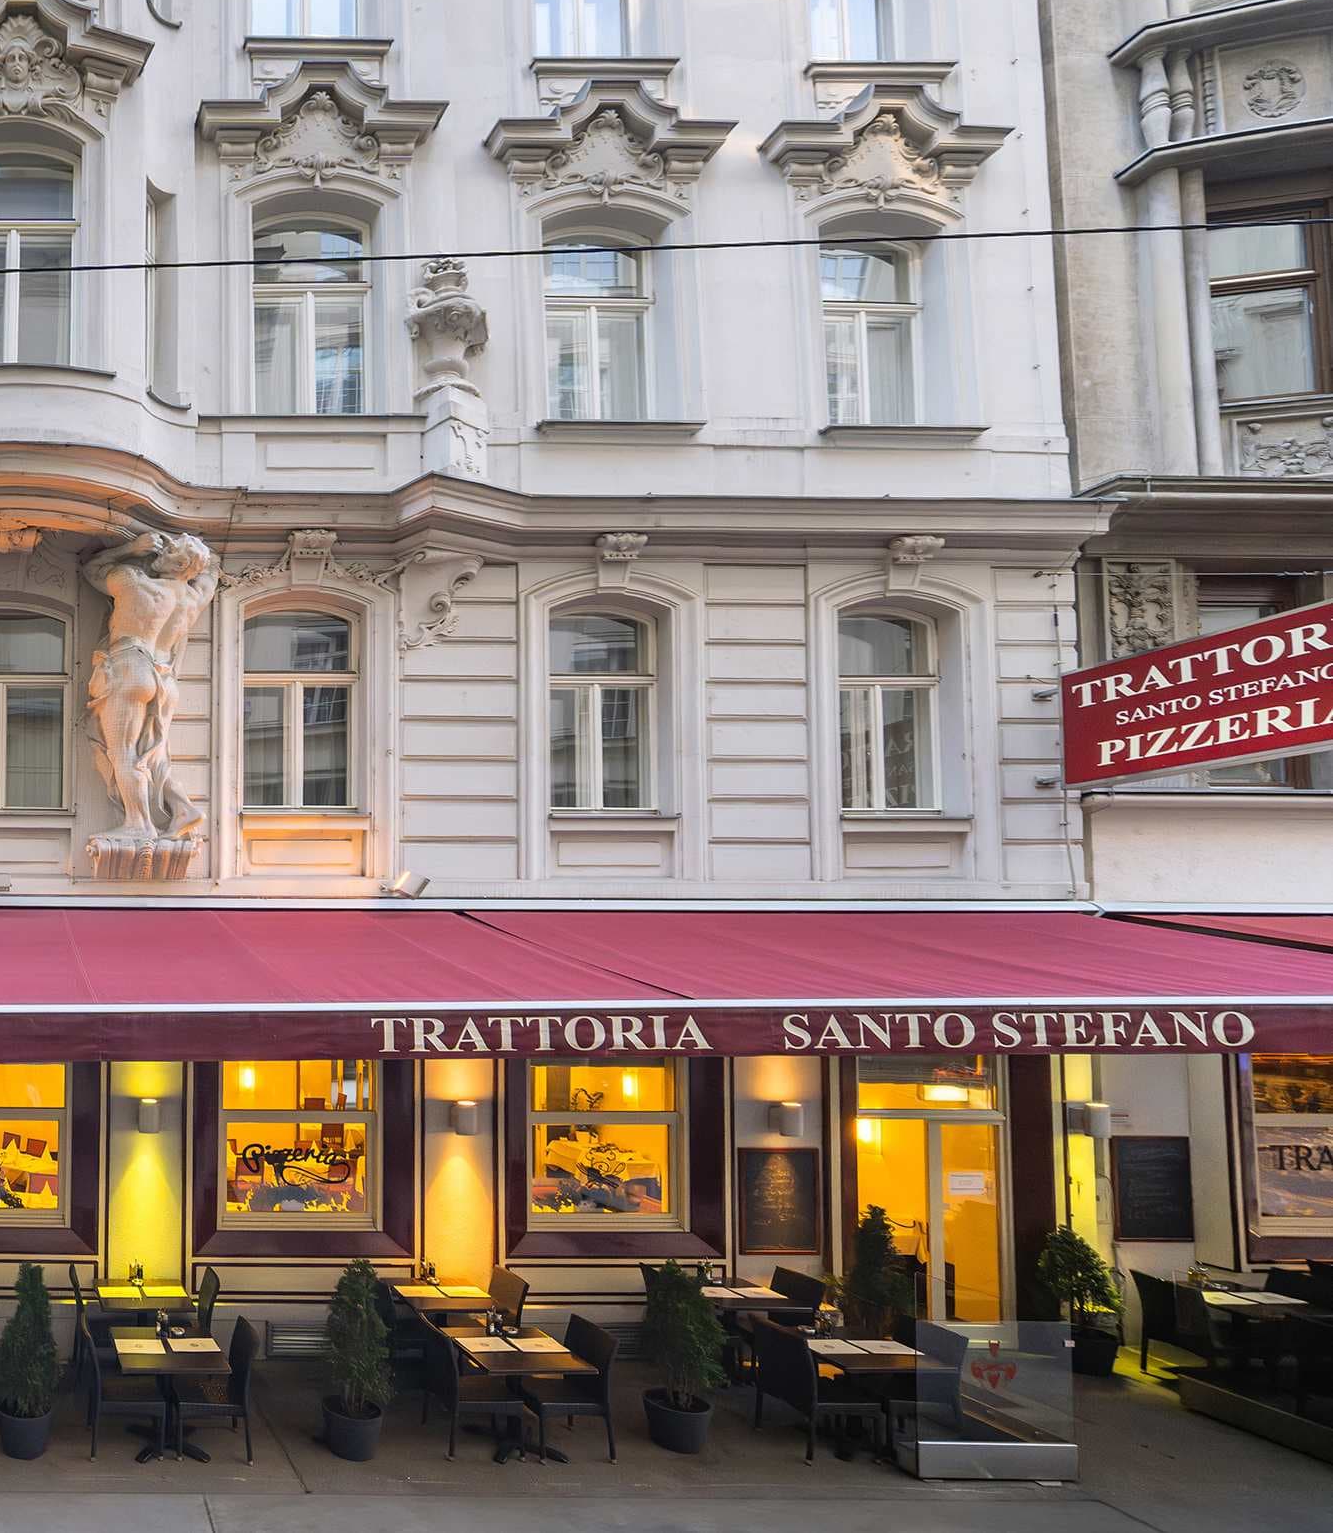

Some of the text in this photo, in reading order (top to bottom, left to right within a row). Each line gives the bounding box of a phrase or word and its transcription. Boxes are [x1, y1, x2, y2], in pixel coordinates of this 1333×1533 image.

[1071, 618, 1333, 708] TRATTOR
[1115, 694, 1202, 726] SANTO
[370, 1014, 714, 1053] TRATTORIA
[782, 1012, 976, 1050] SANTO
[992, 1011, 1255, 1048] STEFANO
